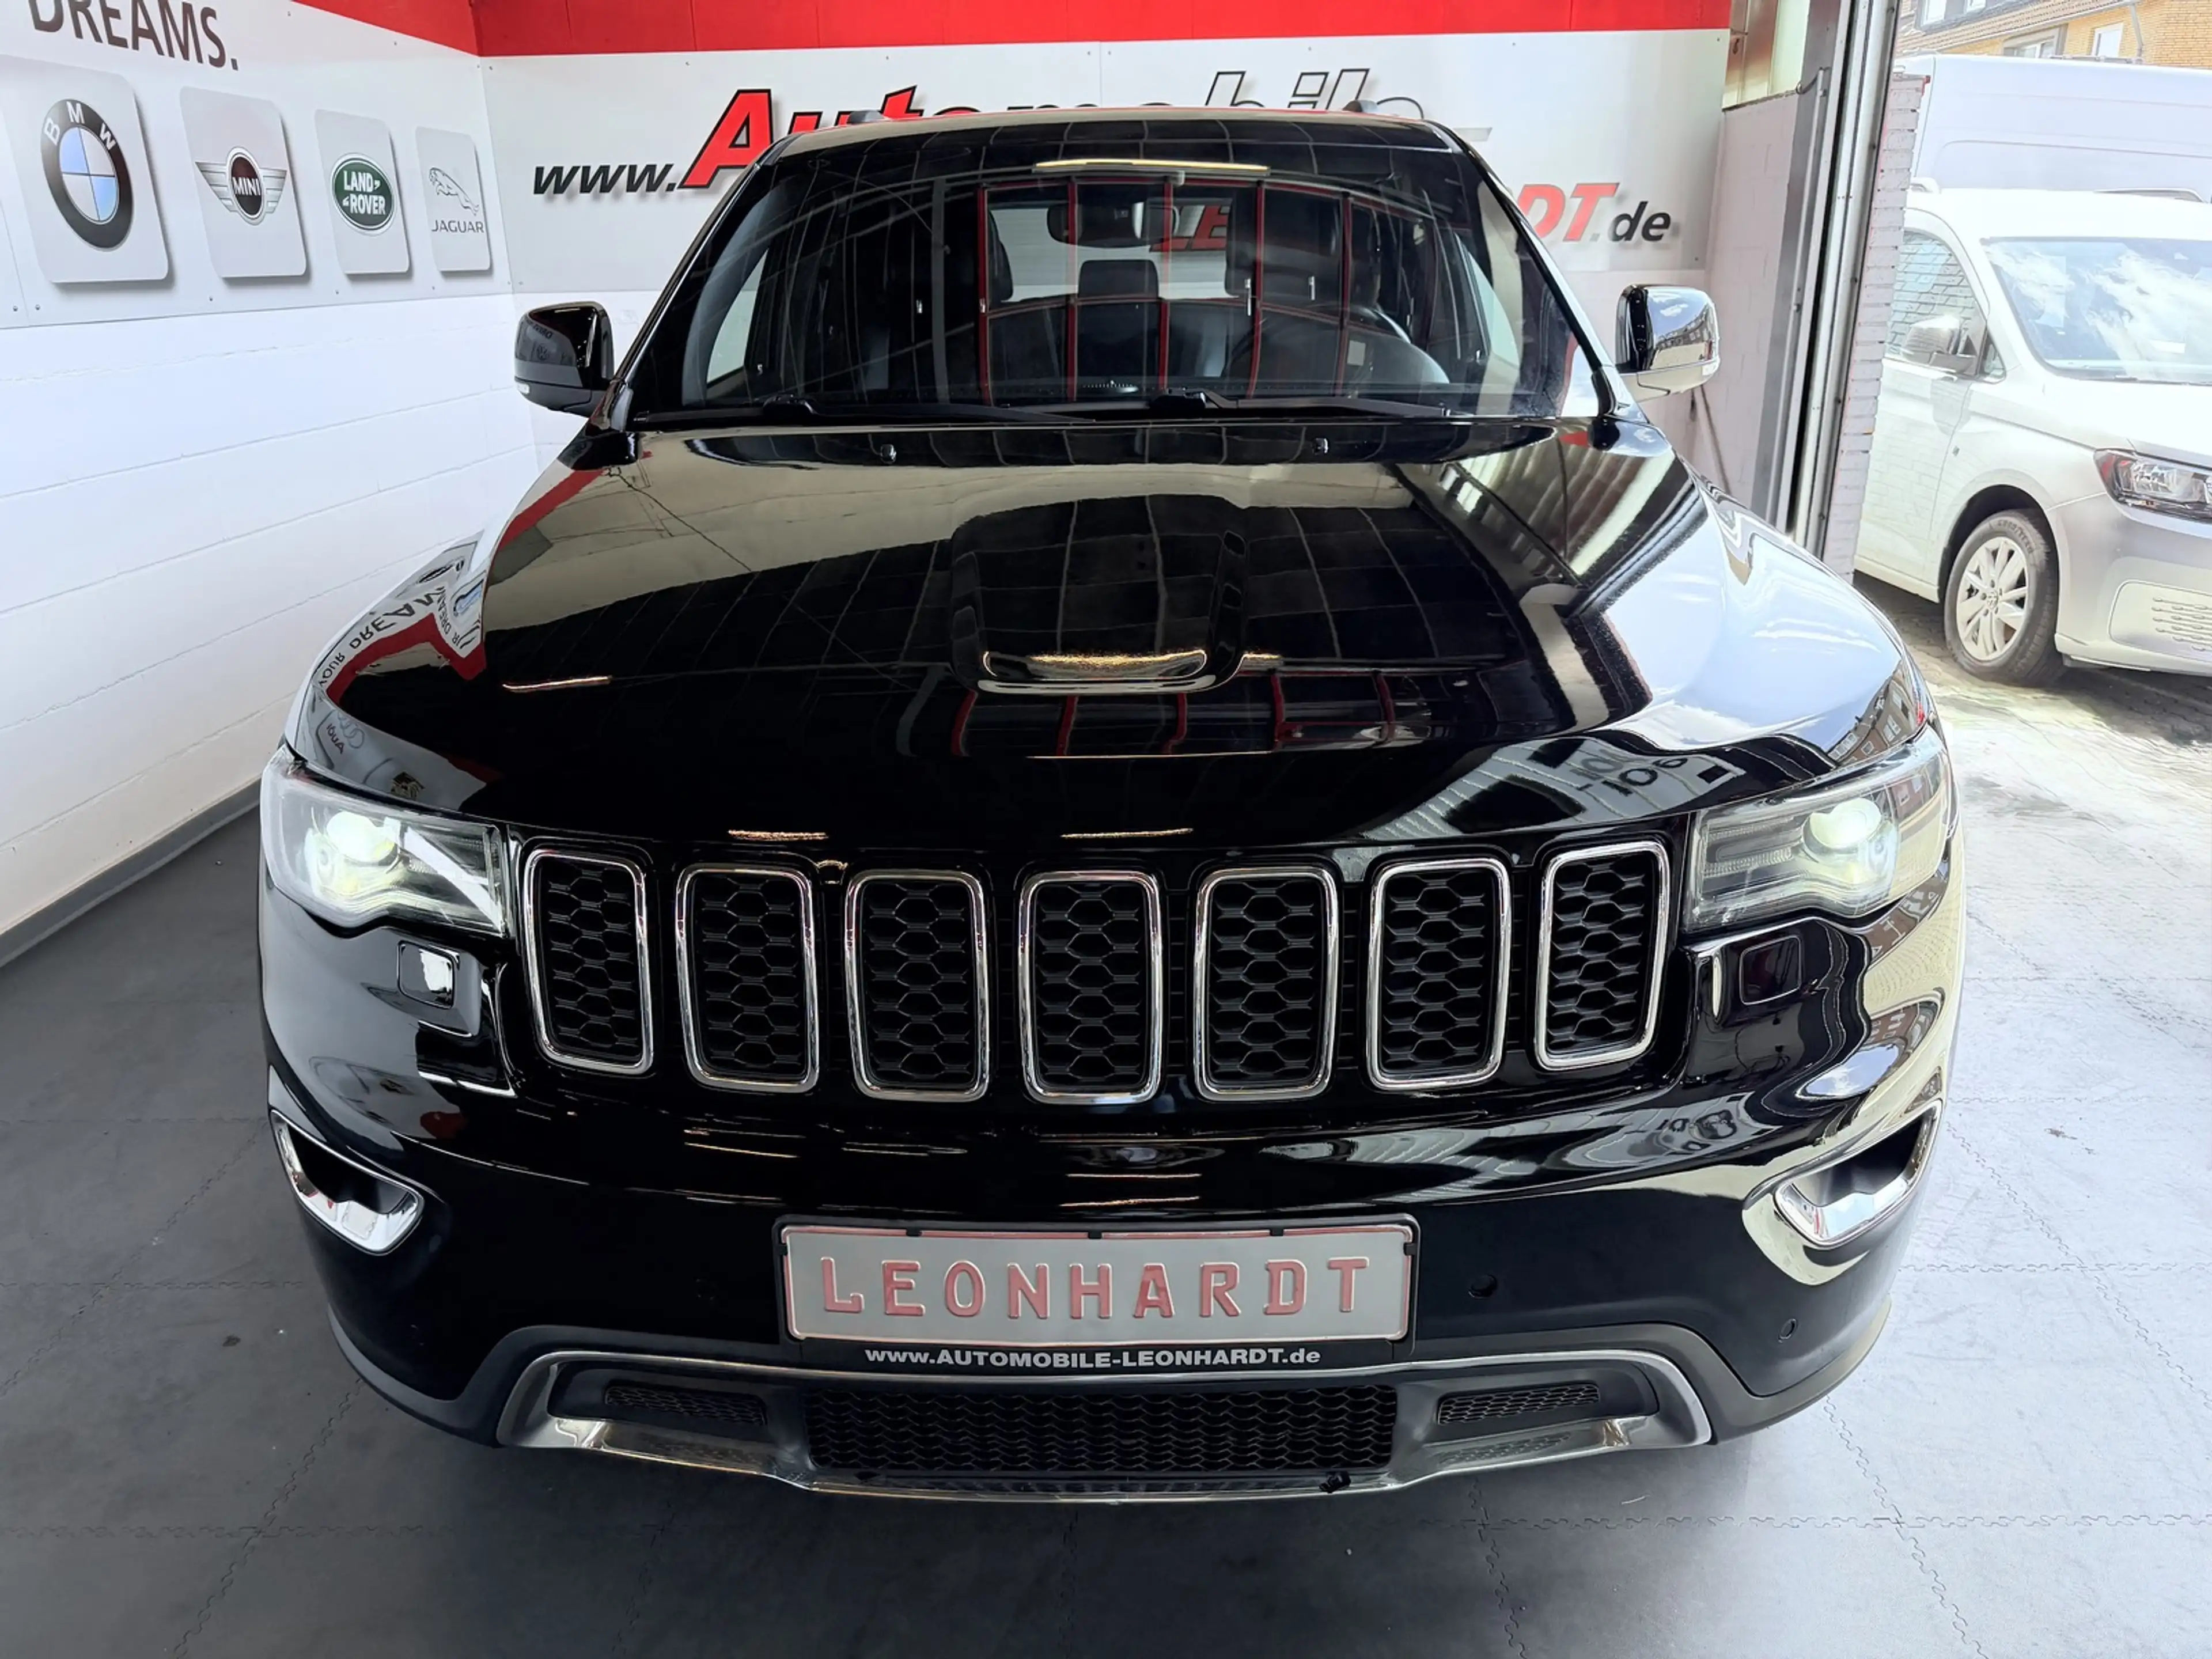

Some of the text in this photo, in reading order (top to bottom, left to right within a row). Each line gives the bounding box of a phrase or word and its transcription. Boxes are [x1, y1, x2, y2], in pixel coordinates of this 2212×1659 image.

[43, 100, 116, 150] BMW
[232, 176, 261, 196] MINI
[344, 170, 373, 192] LAND
[350, 193, 386, 215] ROVER
[431, 219, 484, 233] JAGUAR
[820, 1257, 1369, 1319] LEONHARDT
[864, 1346, 1321, 1369] www.AUTOMOBILE-LEONHARDT.de
